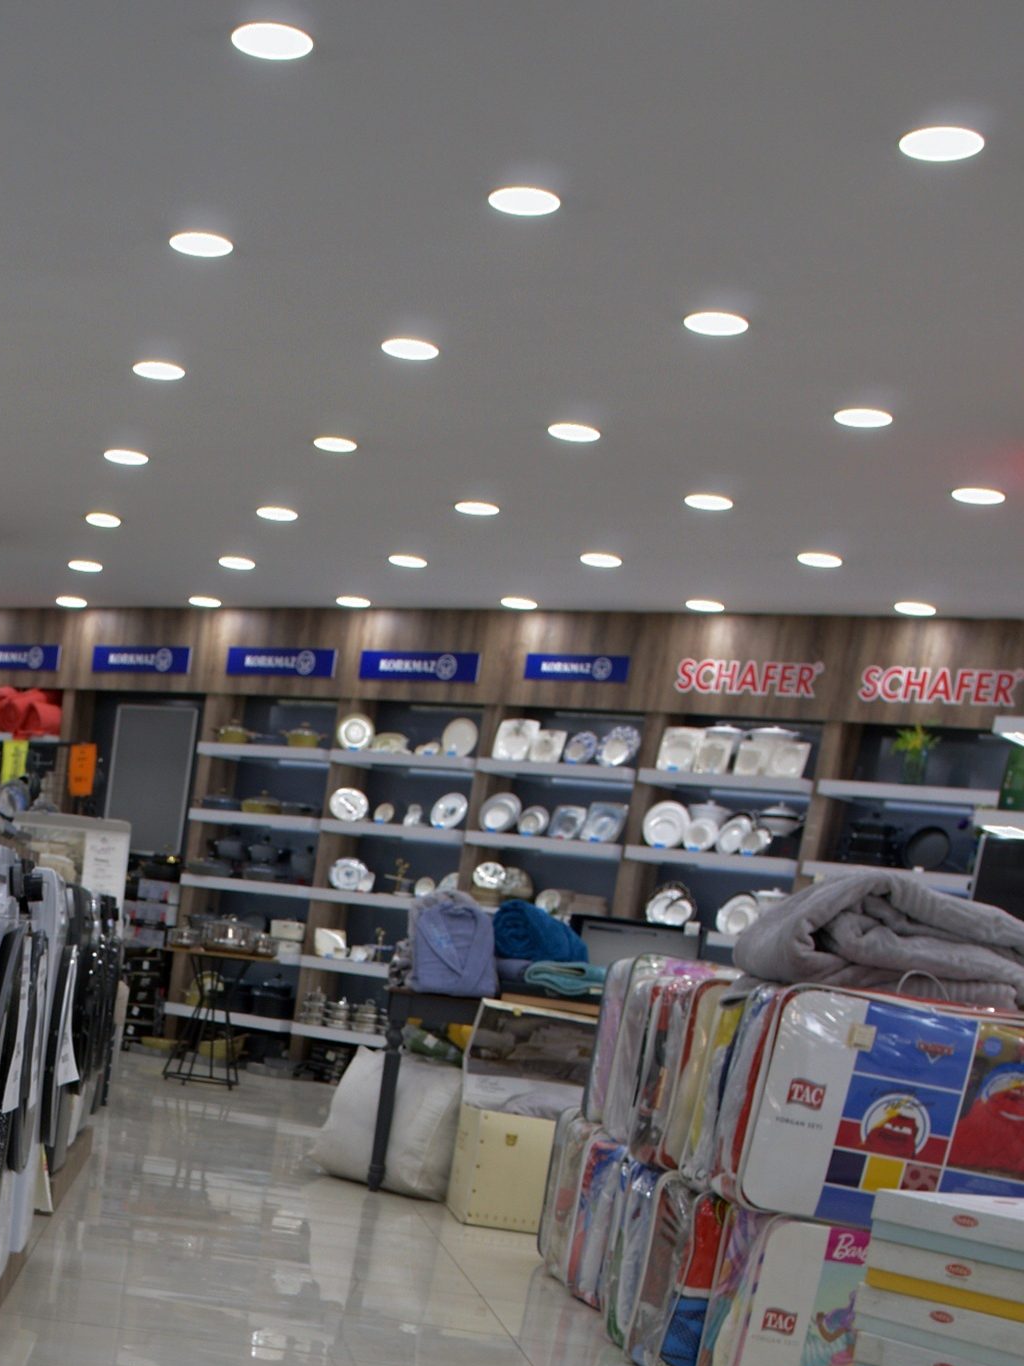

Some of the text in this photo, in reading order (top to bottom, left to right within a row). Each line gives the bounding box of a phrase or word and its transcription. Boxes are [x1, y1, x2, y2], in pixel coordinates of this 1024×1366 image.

[243, 654, 297, 669] KORKMAZ
[378, 658, 437, 674] KORKMAZ
[540, 661, 592, 674] KORKMAZ
[675, 658, 816, 698] SCHAFER
[858, 665, 1015, 707] SCHAFER
[791, 1083, 824, 1106] TAC
[765, 1312, 795, 1331] TAC
